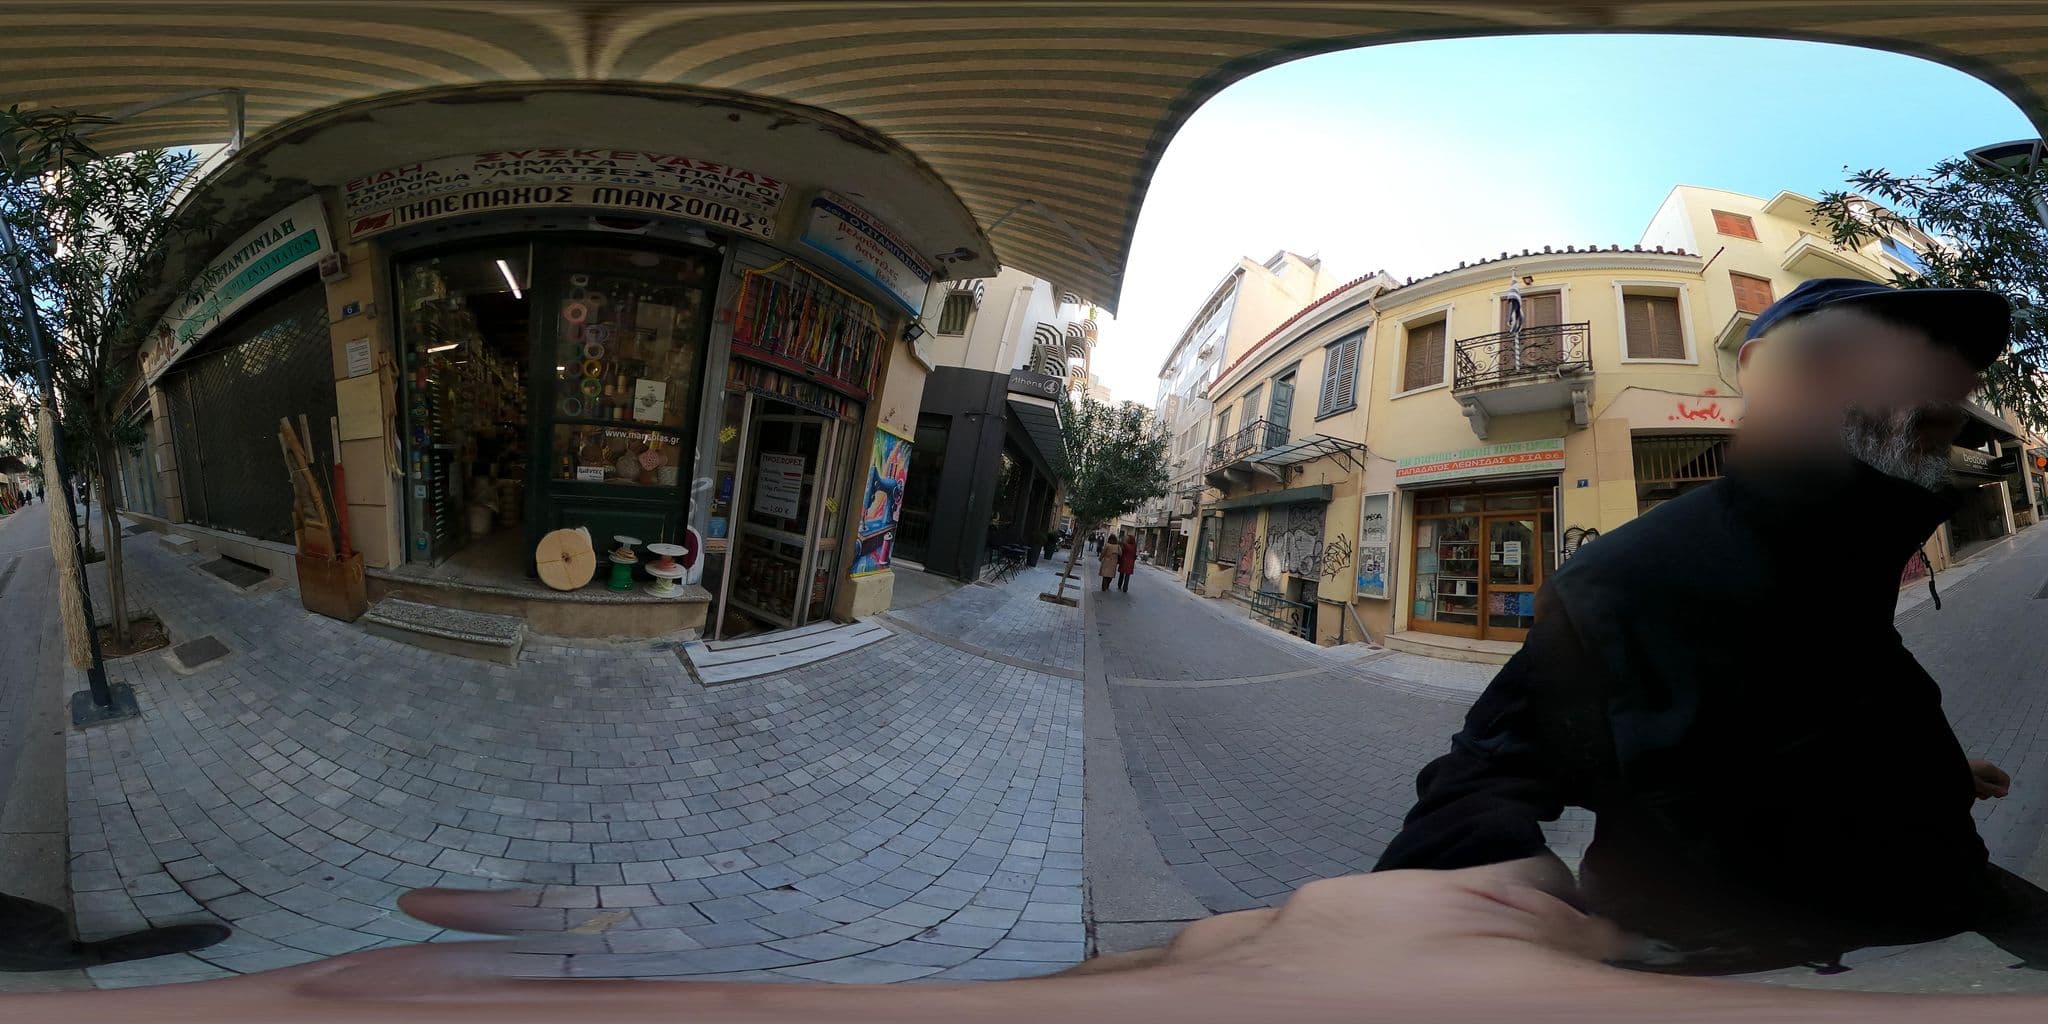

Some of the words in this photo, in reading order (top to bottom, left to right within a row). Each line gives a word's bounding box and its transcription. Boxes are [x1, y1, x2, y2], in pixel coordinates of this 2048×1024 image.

[346, 163, 422, 192] ΕΙΔΗ
[474, 148, 782, 191] ΣΥΣΚΕΥΑΣΙΑΣ
[475, 159, 617, 171] ΝΗΜΑΤΑ
[346, 173, 470, 209] ΚΟΡΔΟΝΙΑ
[675, 174, 777, 207] ΤΑΙΝΙΕΣ
[1451, 457, 1506, 470] ΛΕΩΝΙΔΑΣ
